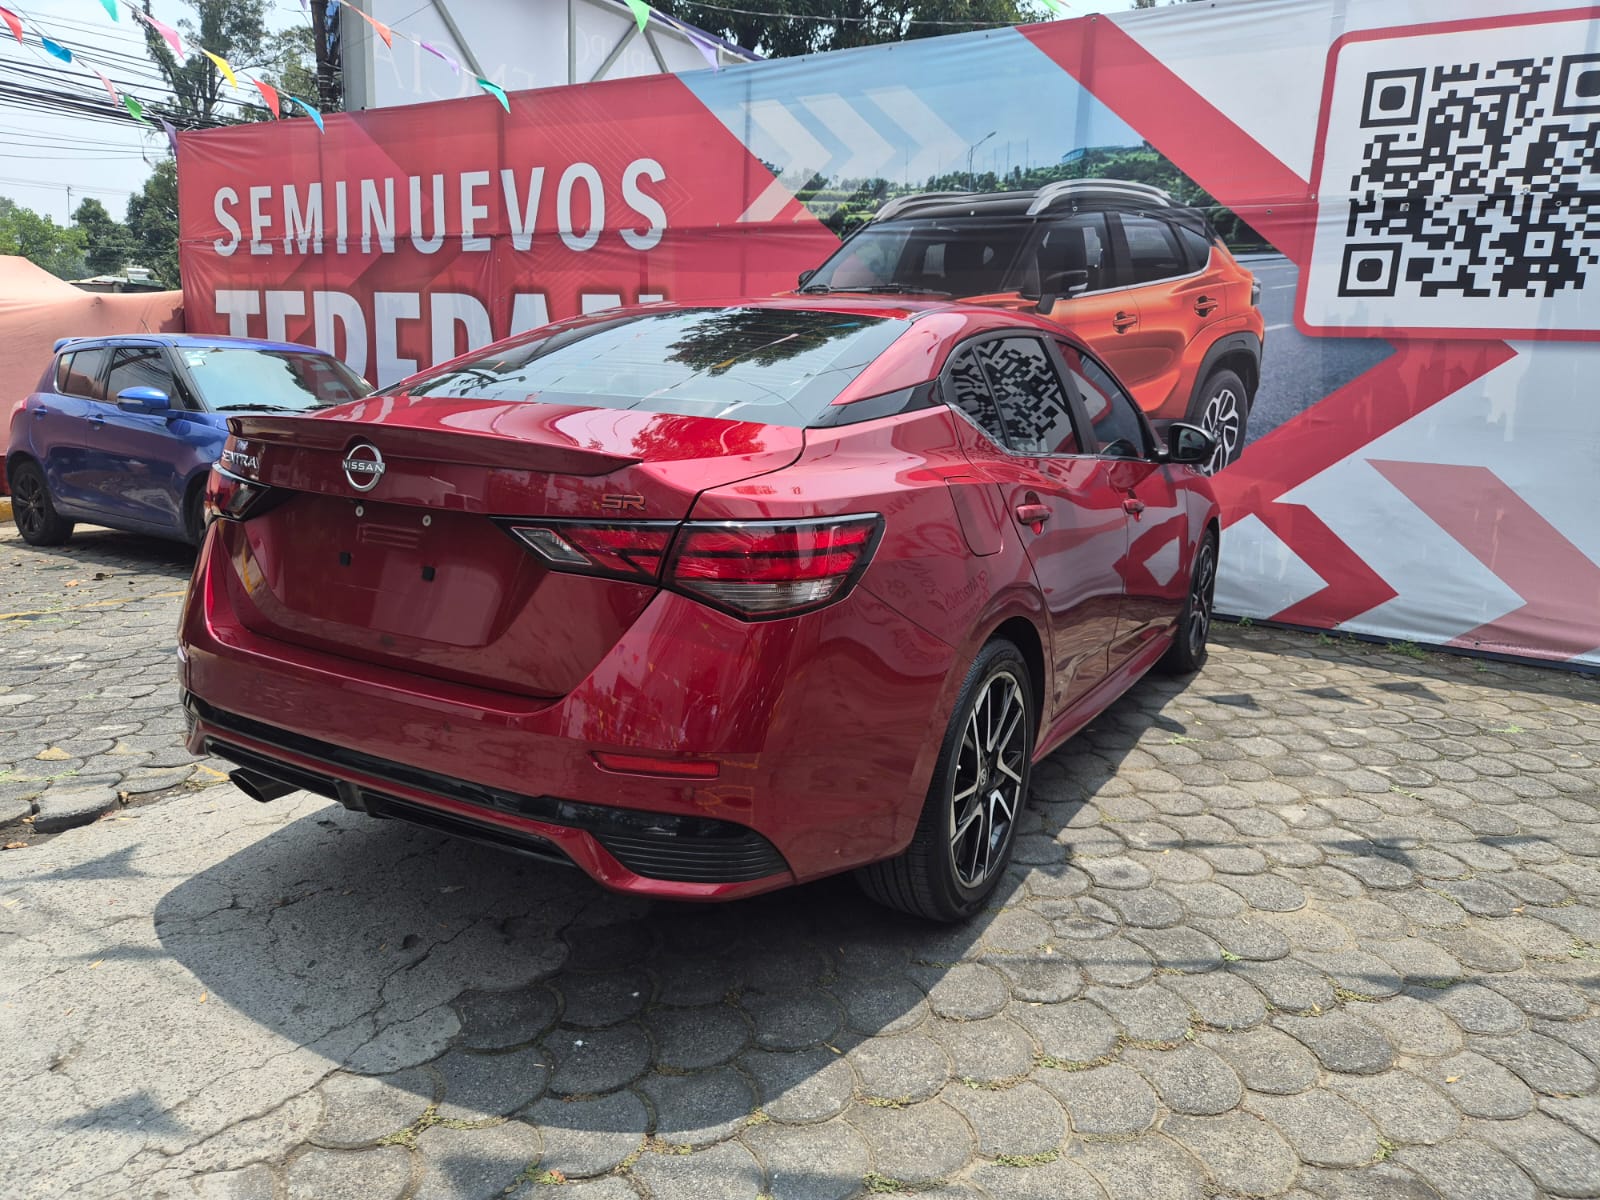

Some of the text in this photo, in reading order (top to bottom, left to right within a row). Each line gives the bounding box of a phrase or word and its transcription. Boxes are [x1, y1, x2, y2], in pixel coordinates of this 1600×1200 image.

[214, 158, 667, 257] SEMINUEVOS
[342, 460, 384, 473] NISSAN
[601, 494, 645, 511] SR
